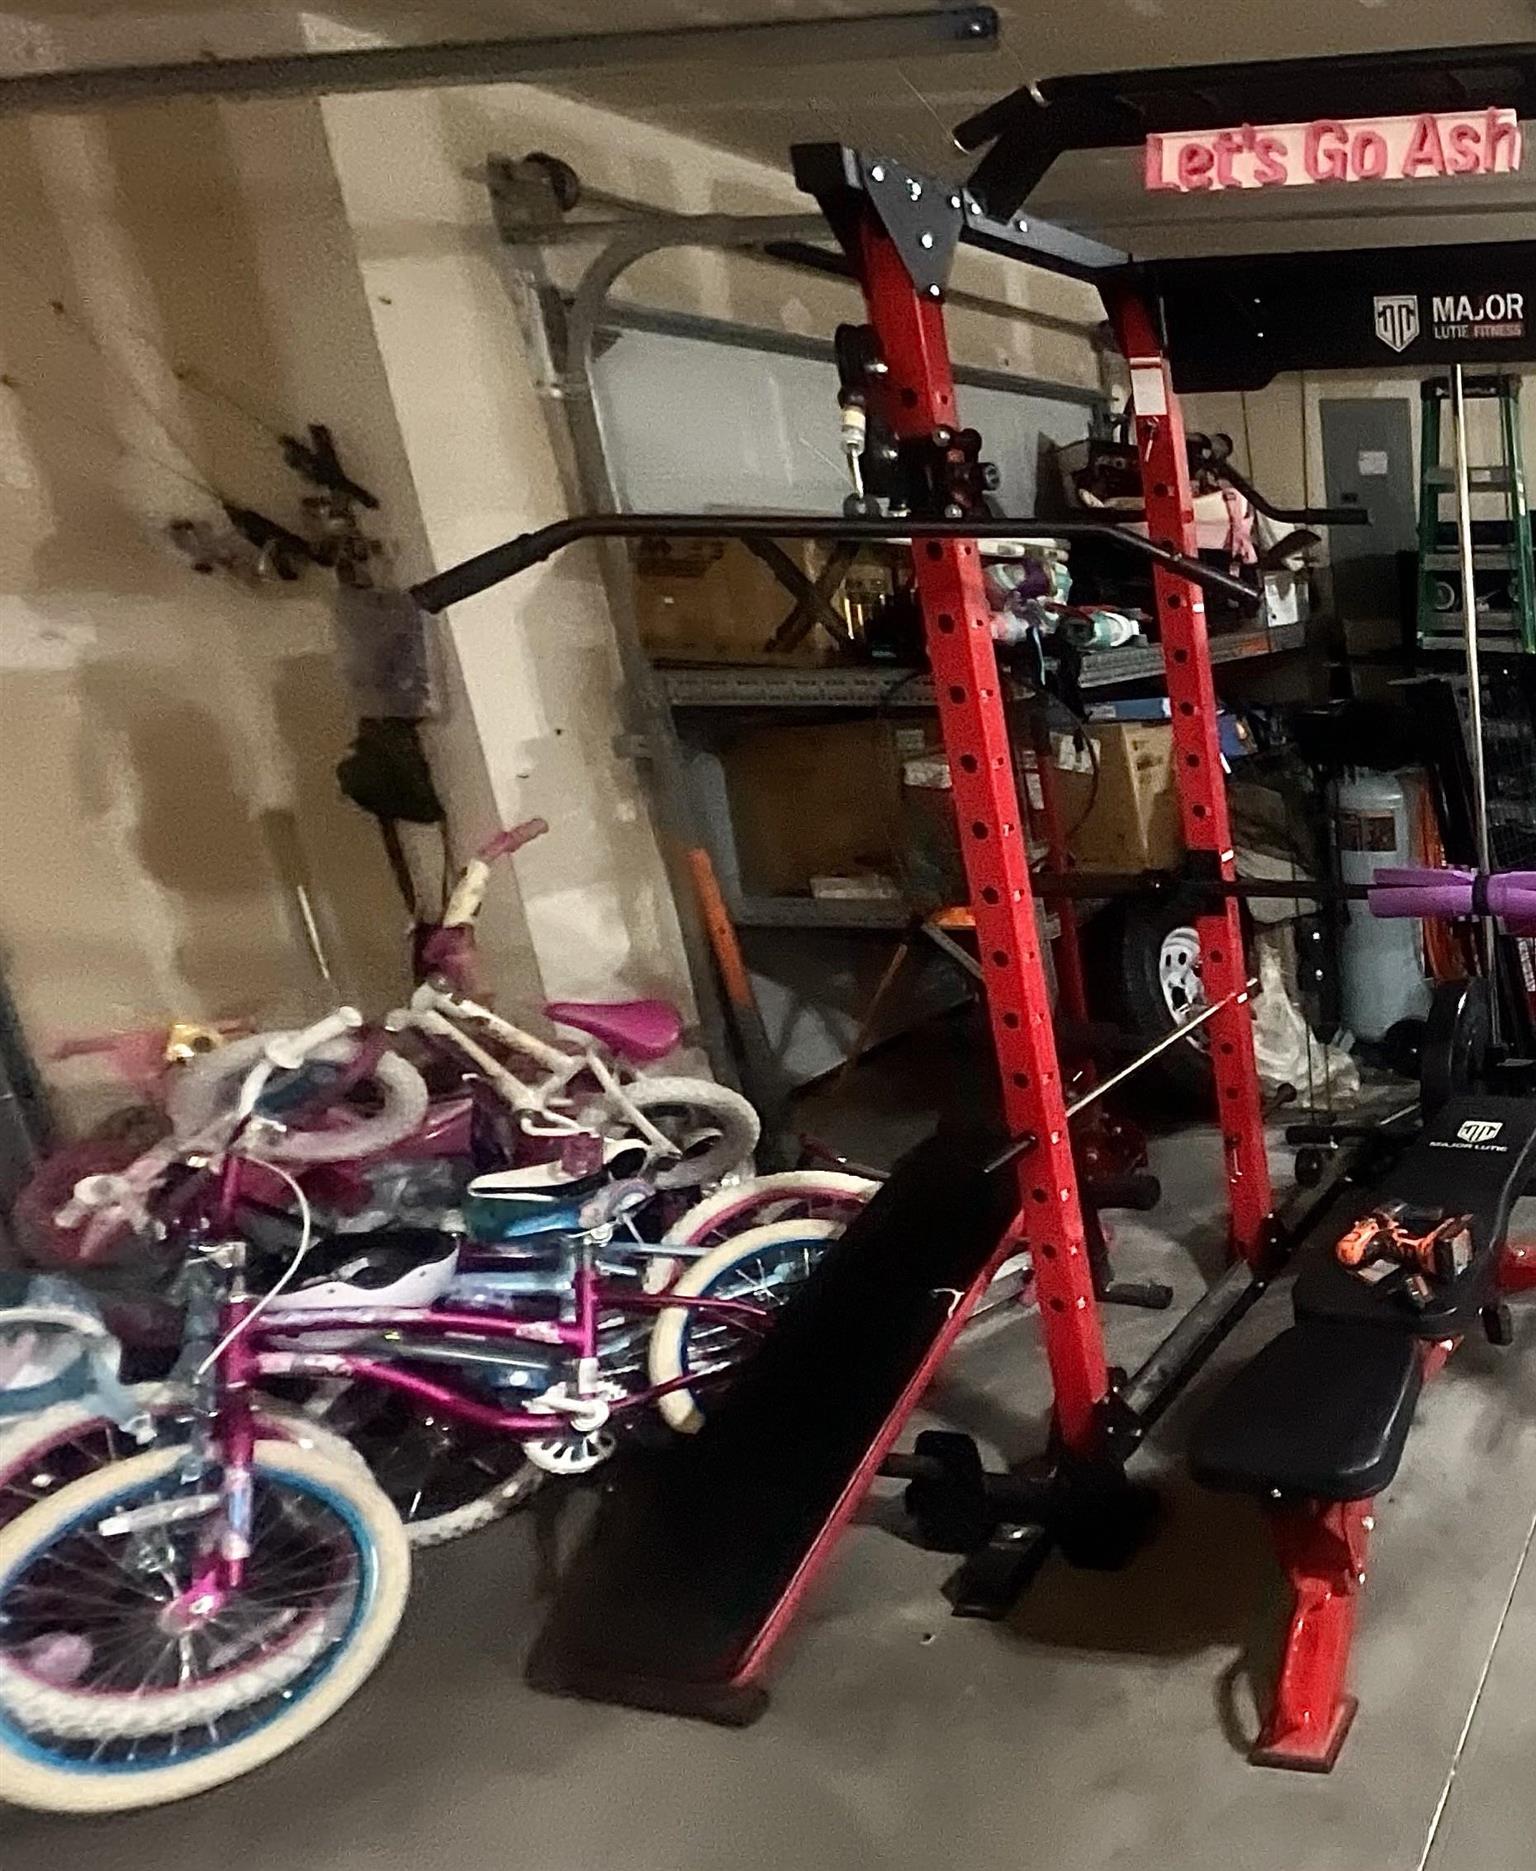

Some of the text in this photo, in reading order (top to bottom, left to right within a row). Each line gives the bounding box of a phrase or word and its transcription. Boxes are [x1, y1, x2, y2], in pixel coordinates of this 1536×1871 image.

[1146, 106, 1521, 192] Let's Go Ash
[1432, 293, 1524, 323] MAJOR
[1434, 321, 1522, 339] LUTIE FITNESS
[1429, 1141, 1473, 1149] MAJOR
